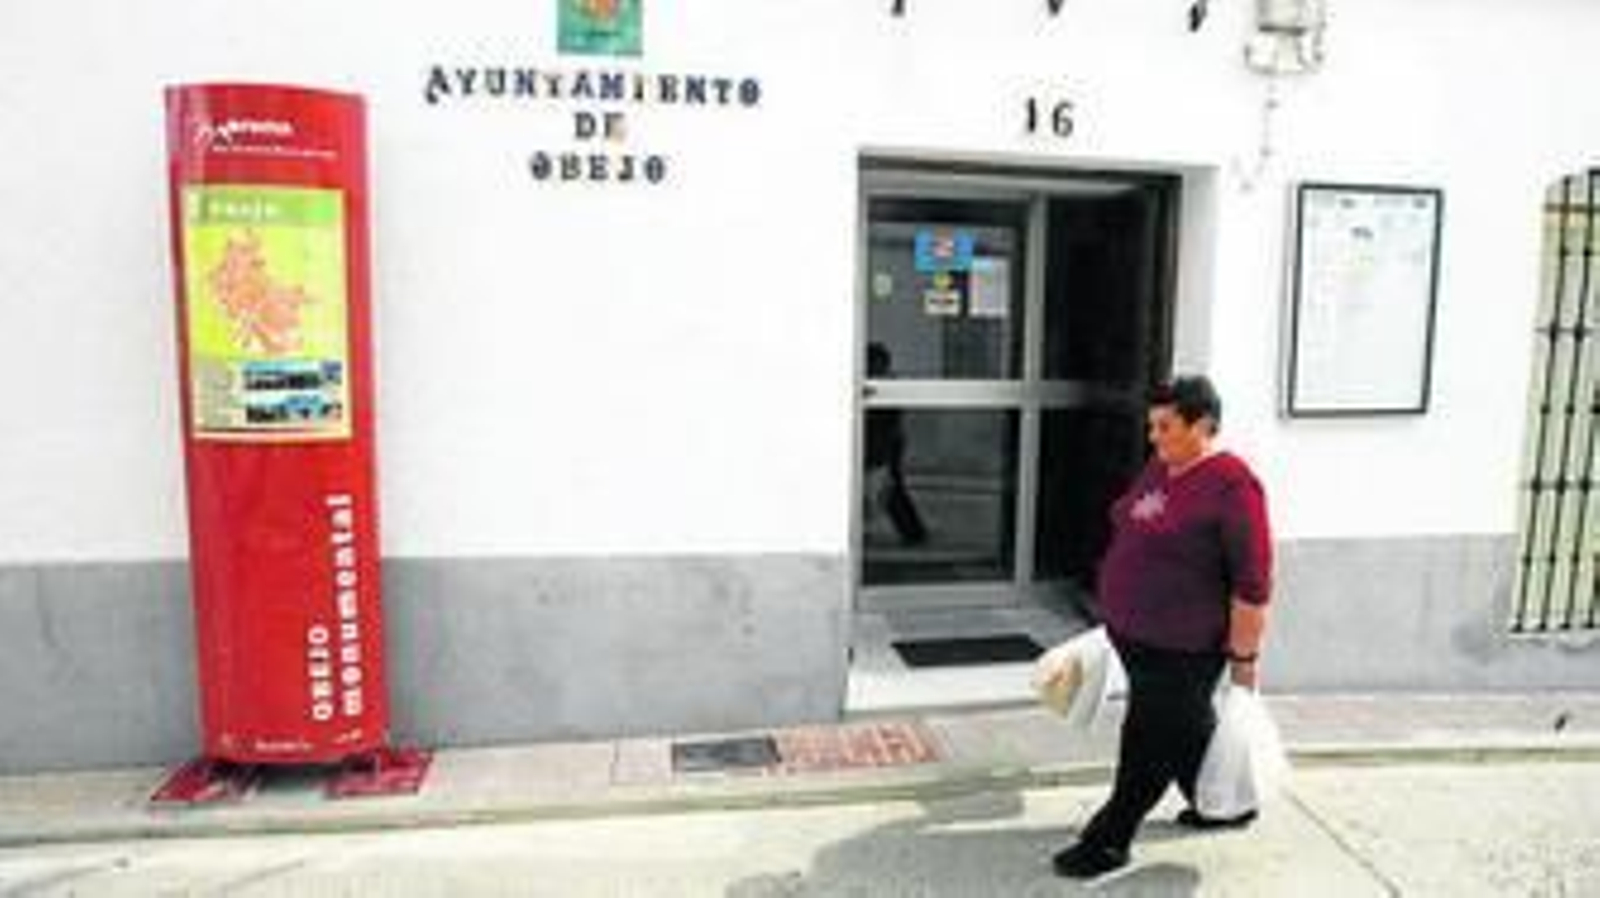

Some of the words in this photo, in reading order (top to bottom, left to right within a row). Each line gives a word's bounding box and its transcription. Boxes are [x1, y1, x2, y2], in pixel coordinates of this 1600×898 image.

[424, 65, 762, 107] AYUNTAMIENTO
[573, 111, 625, 142] DE
[1026, 97, 1074, 138] 16
[530, 151, 667, 184] OBEJO
[326, 494, 363, 716] monumental
[308, 625, 333, 721] OBEJO
